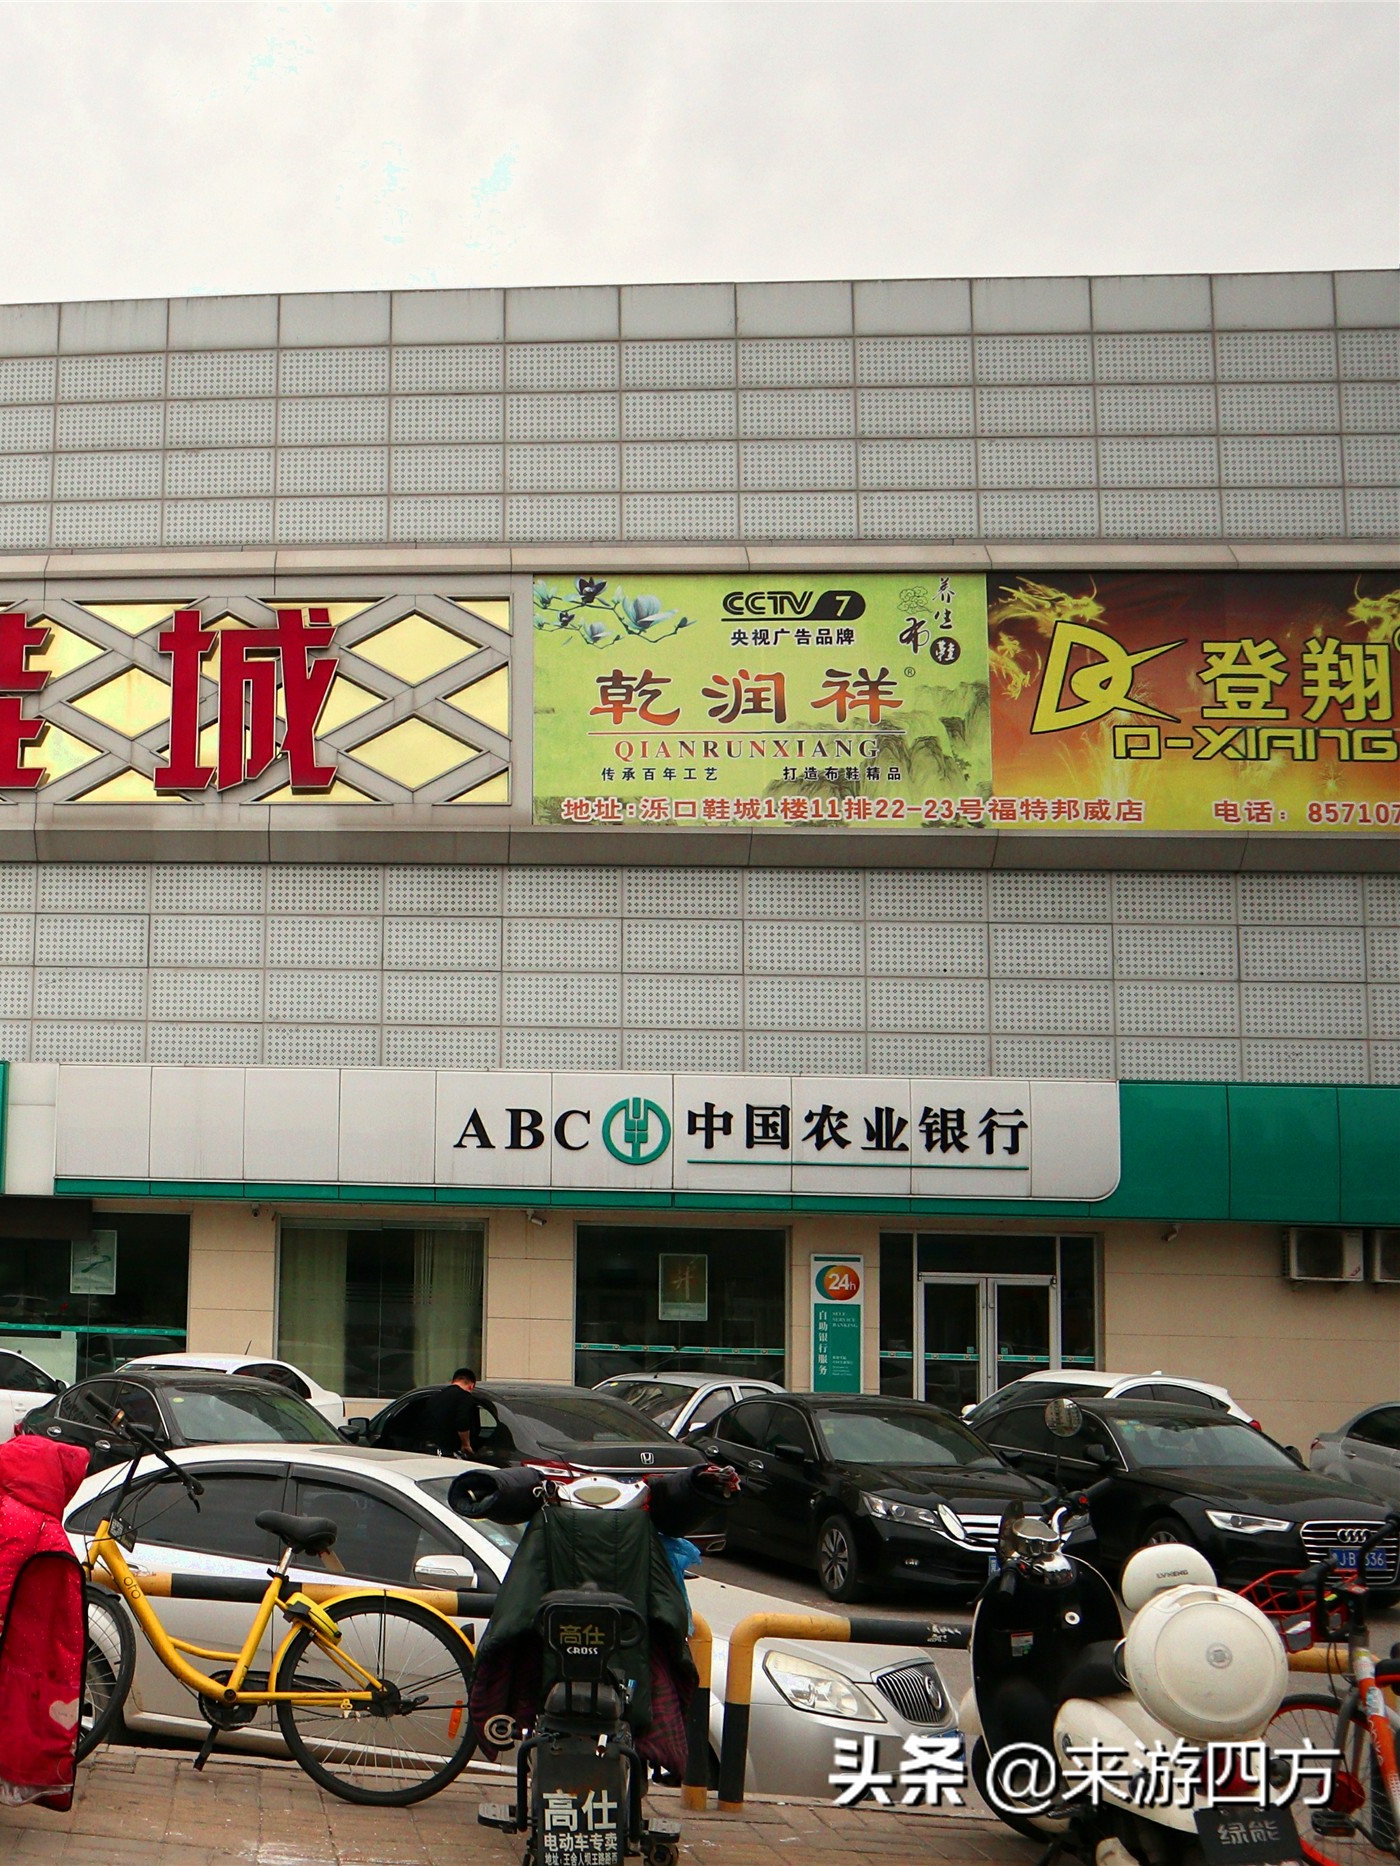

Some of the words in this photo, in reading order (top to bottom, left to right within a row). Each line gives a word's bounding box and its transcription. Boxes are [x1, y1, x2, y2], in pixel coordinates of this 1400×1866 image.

[721, 590, 813, 616] CCTV
[730, 628, 855, 647] 央视广告品牌
[1197, 636, 1393, 722] 登翔
[589, 668, 904, 726] 乾润祥
[614, 739, 880, 759] QIANRUNXIANG
[601, 766, 718, 781] 传承百年工艺
[783, 766, 902, 781] 打造布鞋精品
[453, 1107, 591, 1151] ABC
[687, 1101, 1029, 1155] 中国农业银行
[828, 1273, 856, 1290] 24h
[818, 1310, 828, 1376] 自助银行服务
[560, 1624, 605, 1645] 高仕
[566, 1646, 598, 1654] CROSS
[542, 1787, 618, 1832] 高仕
[543, 1832, 618, 1852] 电动车专卖
[1217, 1820, 1281, 1845] 绿能
